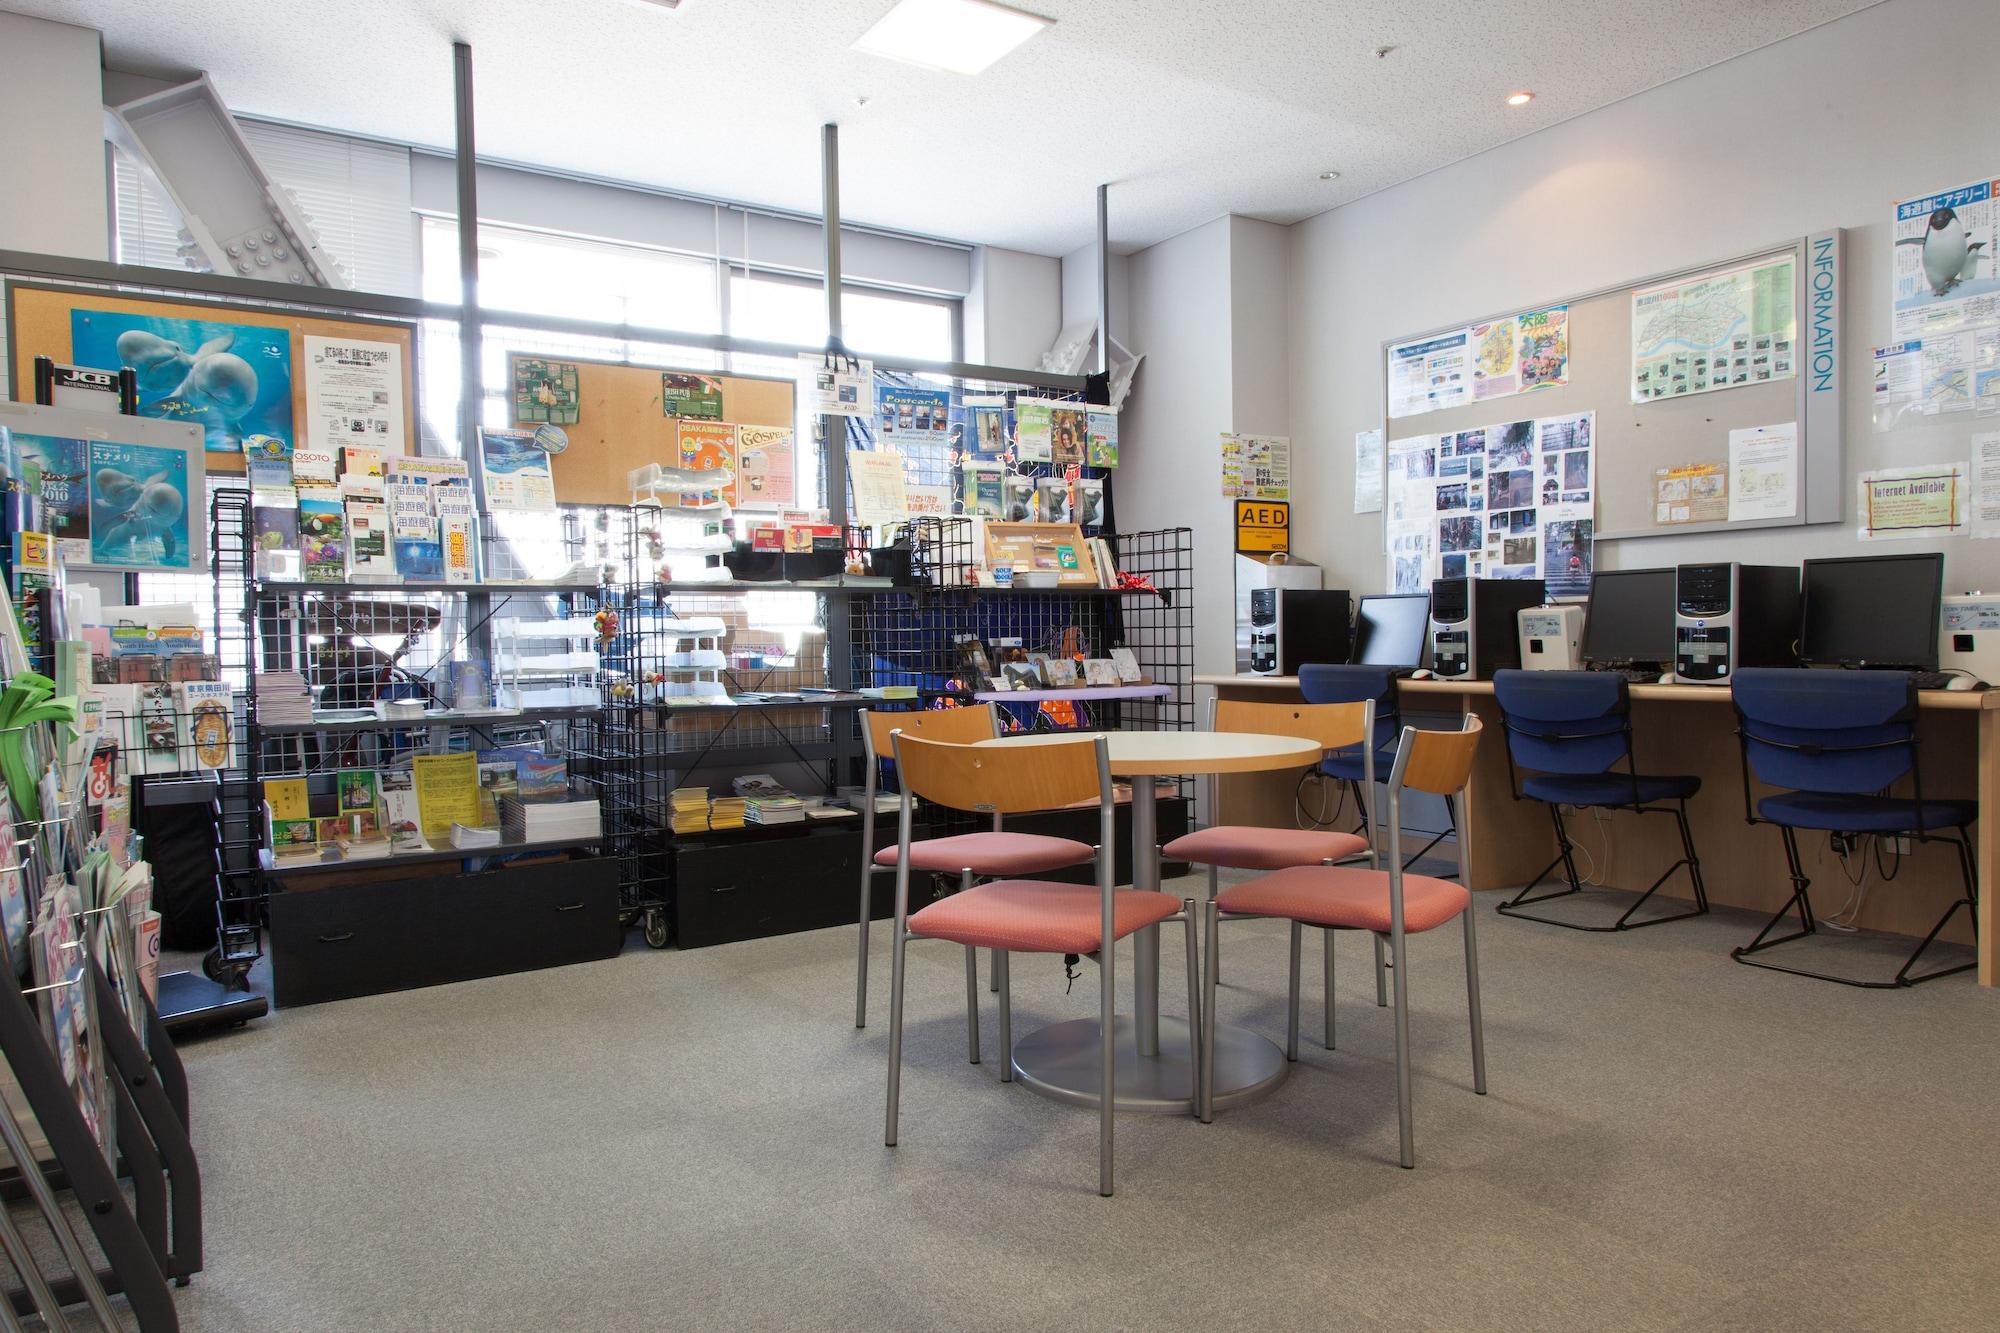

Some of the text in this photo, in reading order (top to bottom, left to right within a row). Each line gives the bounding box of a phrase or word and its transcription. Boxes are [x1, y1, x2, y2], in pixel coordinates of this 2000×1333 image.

[1518, 311, 1548, 329] 大阪
[1813, 237, 1833, 392] INFORMATION
[63, 370, 111, 385] JCB
[63, 381, 111, 391] INTERNATIONAL
[885, 394, 944, 406] Postcards
[93, 451, 131, 462] スナメリ
[1873, 482, 1946, 498] Internet Available
[1241, 508, 1285, 524] AED
